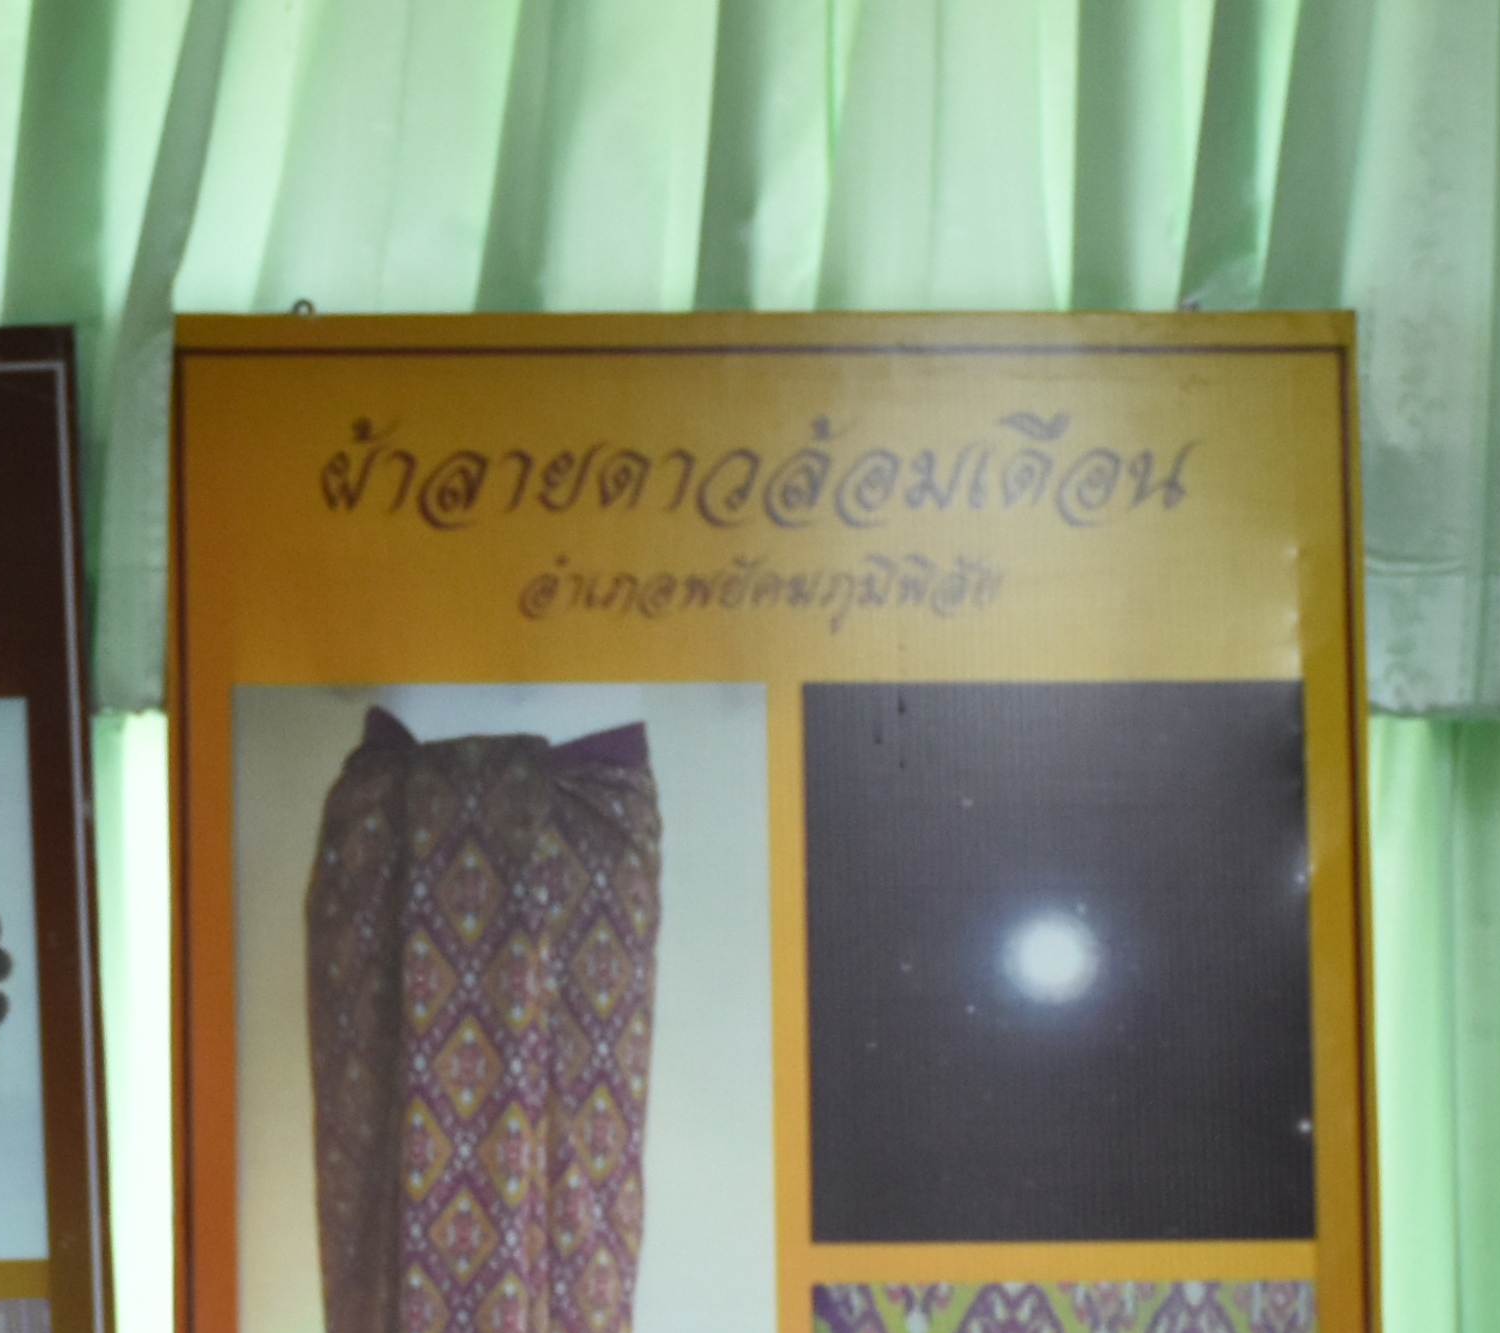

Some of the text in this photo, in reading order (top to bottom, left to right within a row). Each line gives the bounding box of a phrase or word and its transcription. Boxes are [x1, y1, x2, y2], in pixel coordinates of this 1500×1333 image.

[320, 411, 1202, 530] ผ้าลายดาวล้อมเดือน
